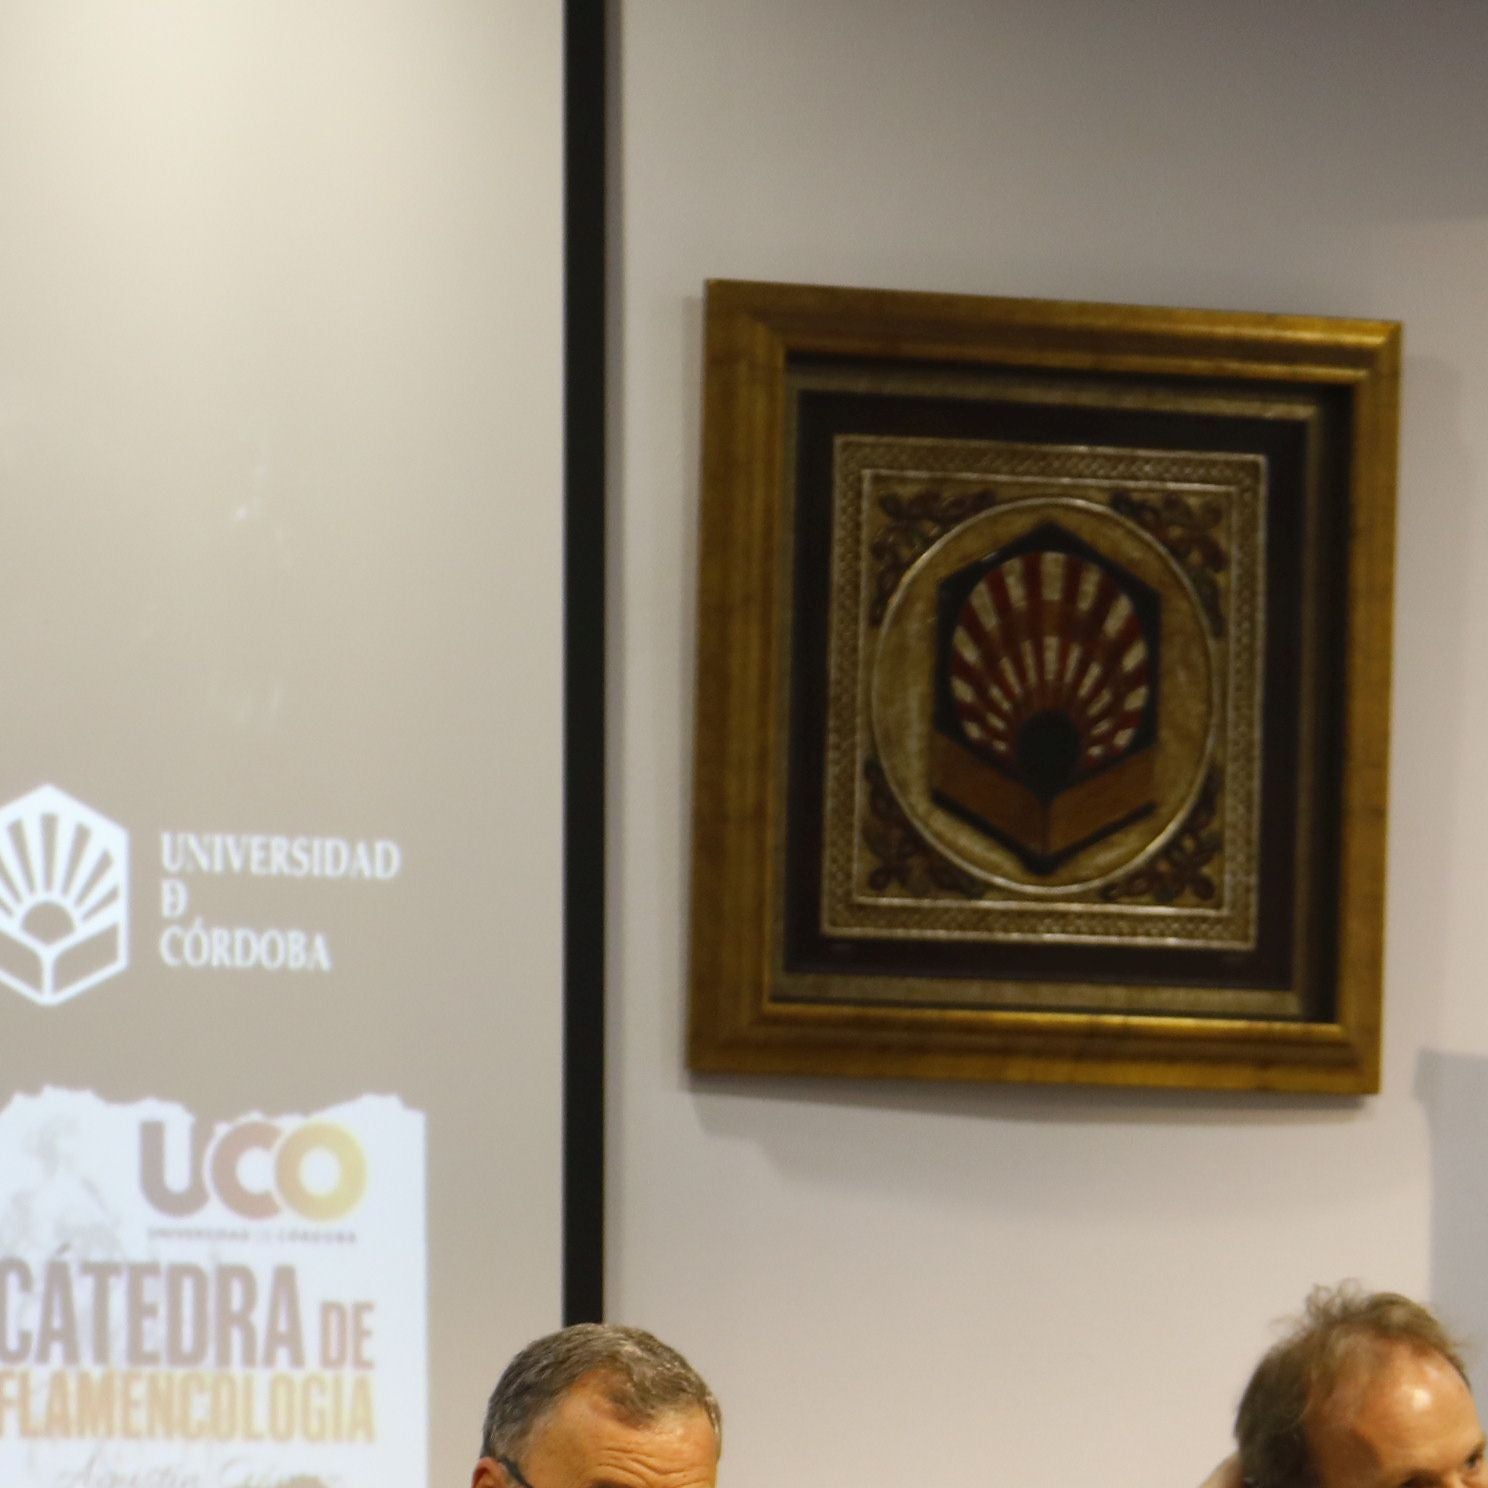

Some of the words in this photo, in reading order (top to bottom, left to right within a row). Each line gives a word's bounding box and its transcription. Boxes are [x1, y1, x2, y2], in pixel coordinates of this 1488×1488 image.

[160, 832, 403, 880] UNIVERSIDAD
[159, 915, 332, 972] CÓRDOBA
[138, 1119, 367, 1223] UCO
[319, 1300, 376, 1372] DE
